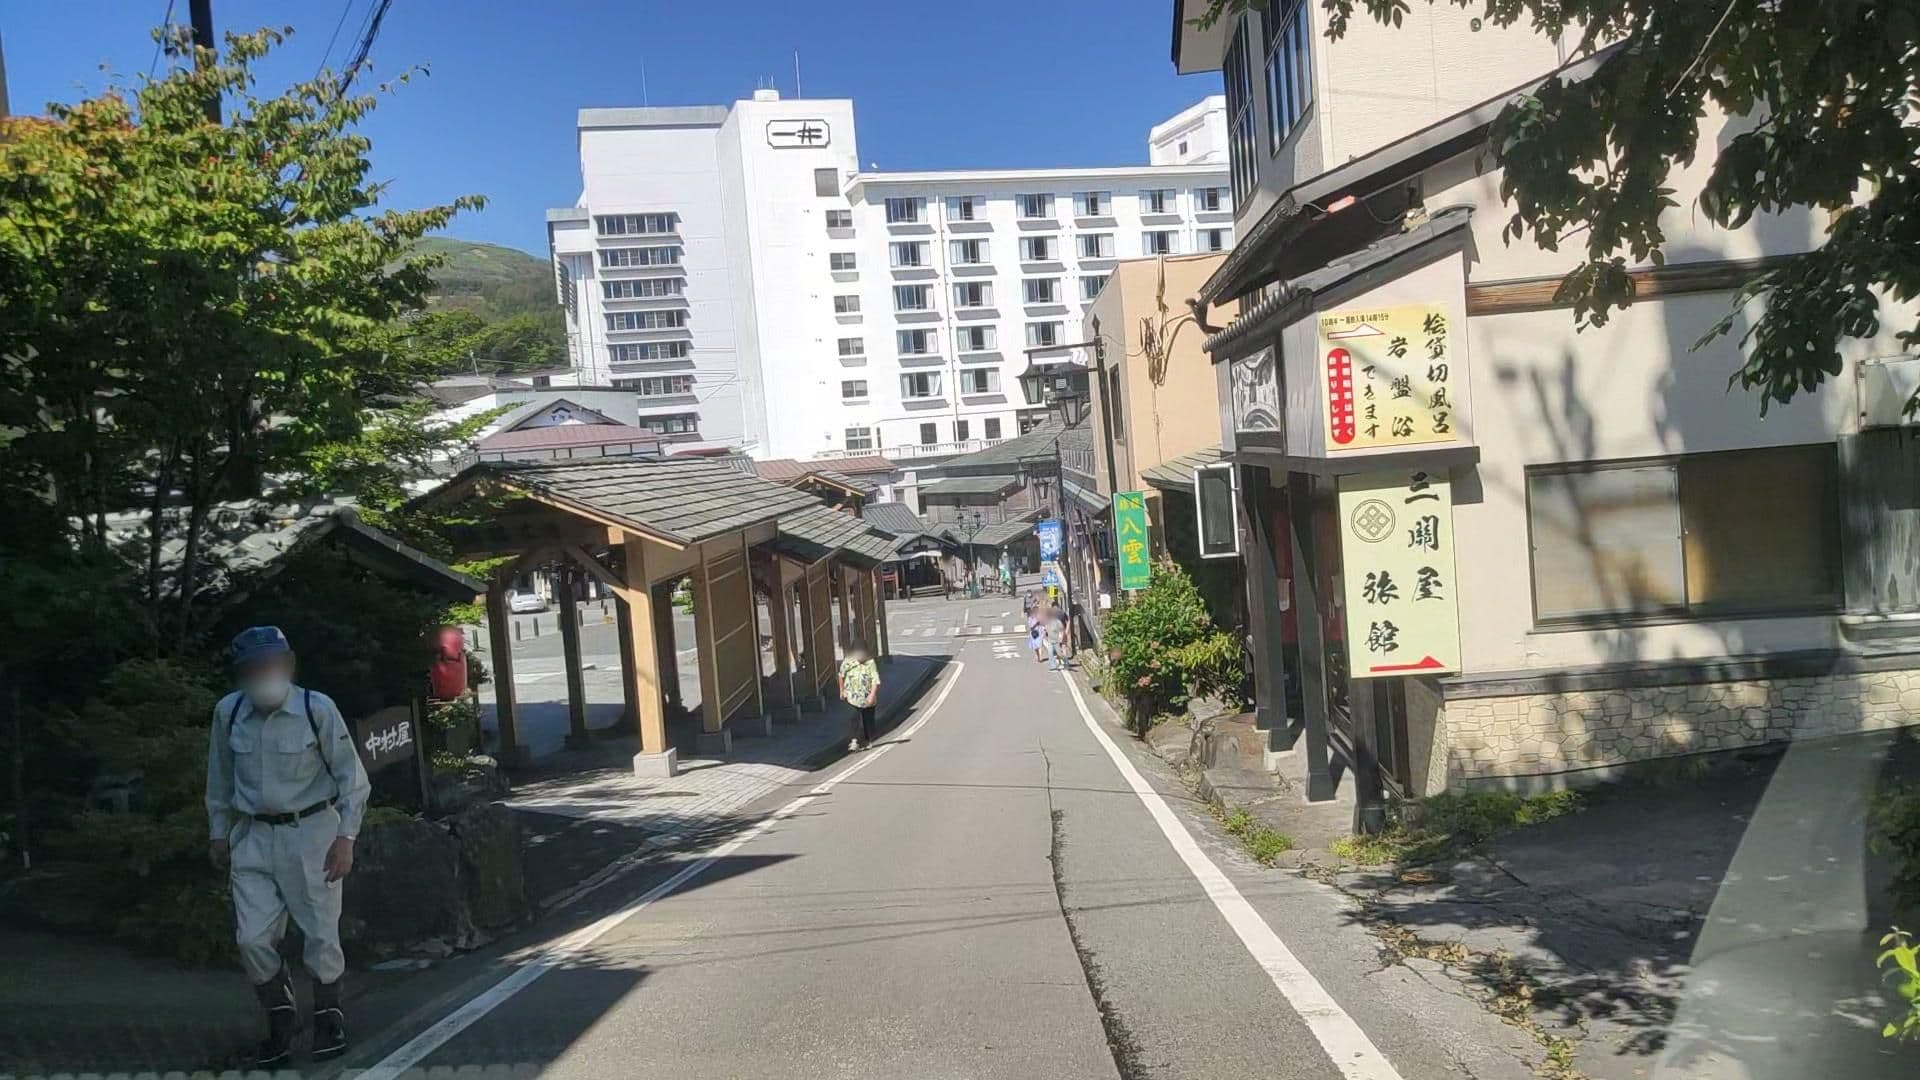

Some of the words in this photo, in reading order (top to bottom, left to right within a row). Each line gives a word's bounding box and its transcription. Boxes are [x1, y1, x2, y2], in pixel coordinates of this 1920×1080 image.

[772, 121, 822, 144] 一井
[1362, 365, 1380, 437] できます
[1387, 336, 1416, 437] 岩盤浴
[1122, 518, 1144, 564] 八雲
[366, 721, 412, 760] 中村屋
